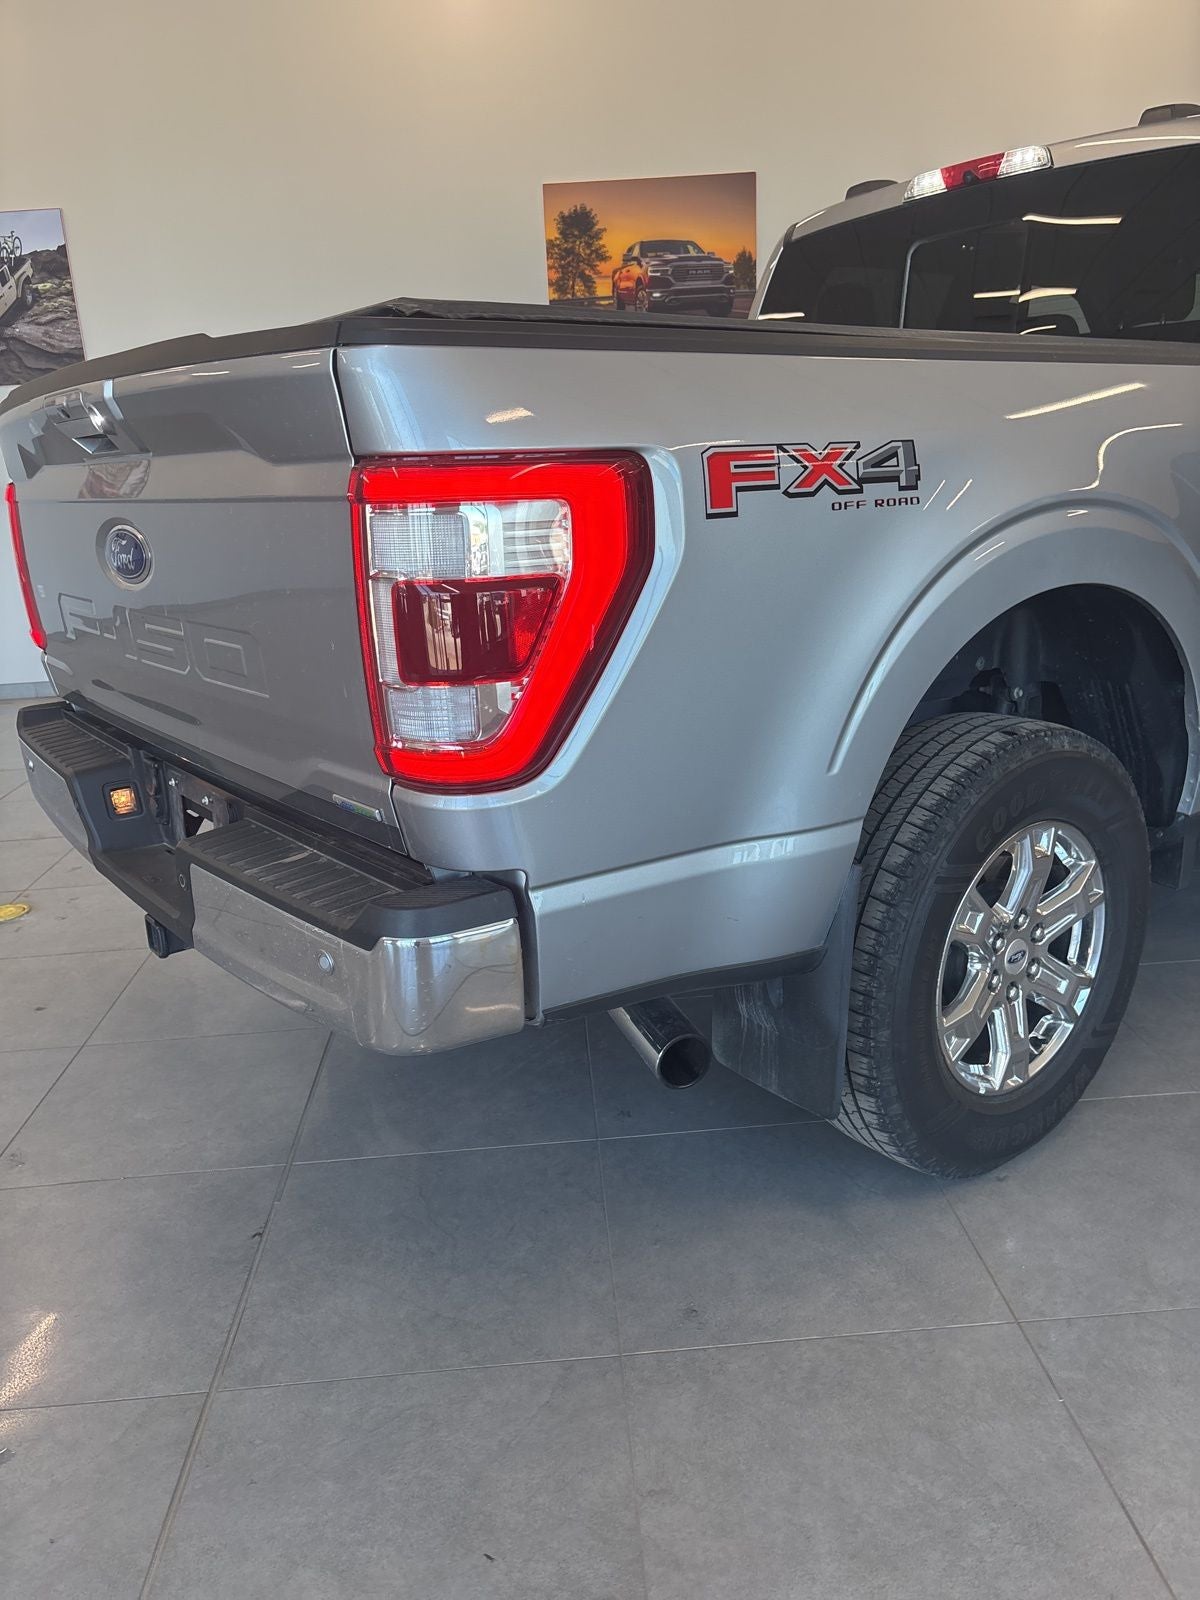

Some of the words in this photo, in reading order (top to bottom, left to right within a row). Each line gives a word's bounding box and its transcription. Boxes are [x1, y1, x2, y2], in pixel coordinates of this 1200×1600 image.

[701, 439, 920, 519] FX4
[831, 500, 867, 512] OFF
[874, 496, 921, 509] ROAD
[111, 537, 135, 570] Ford
[58, 592, 270, 699] F-150
